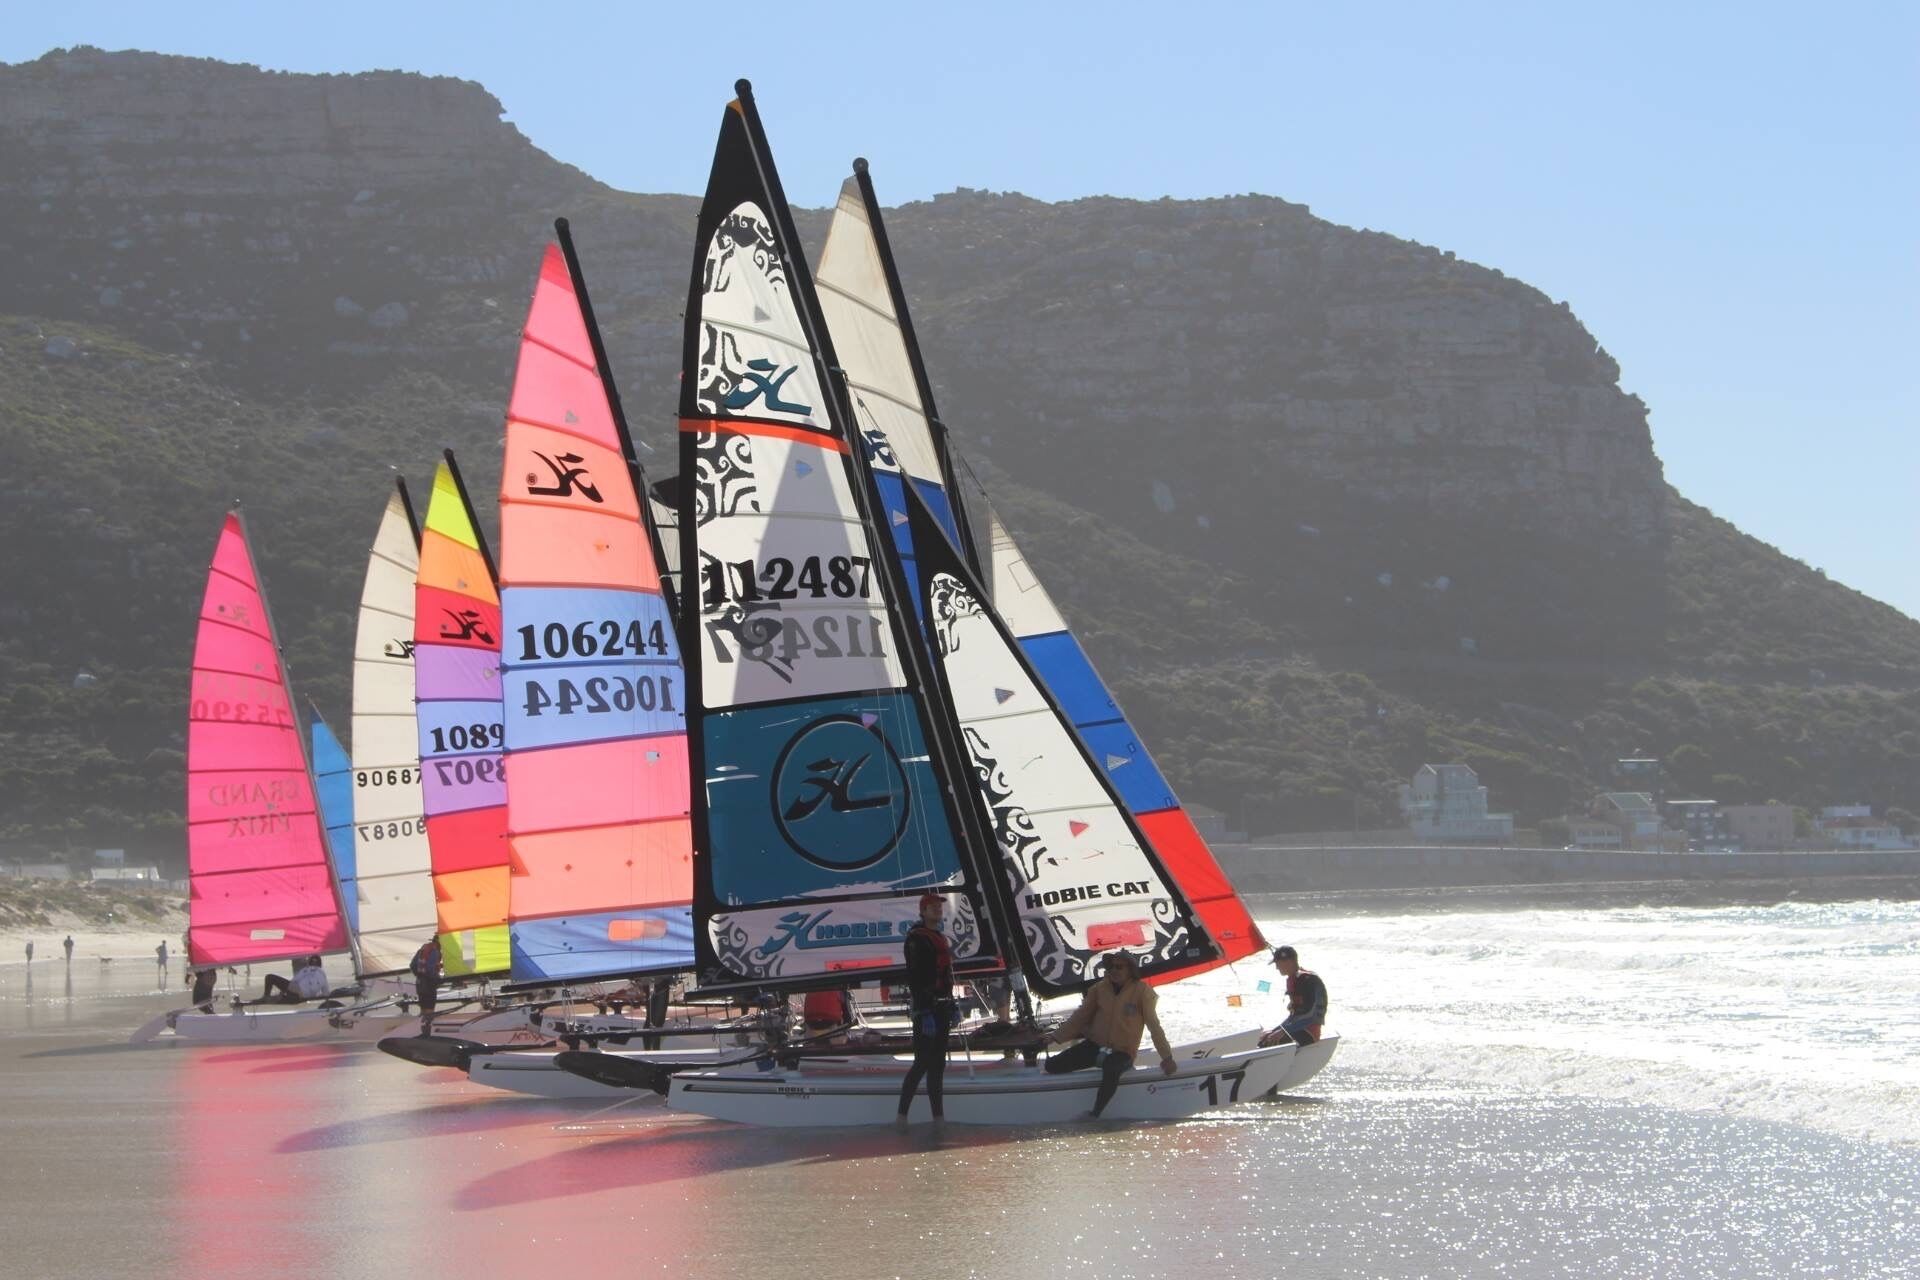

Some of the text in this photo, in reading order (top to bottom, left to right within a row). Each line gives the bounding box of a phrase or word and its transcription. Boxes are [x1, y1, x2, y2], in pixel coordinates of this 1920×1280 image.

[702, 556, 871, 603] 112487
[517, 619, 668, 660] 106244
[430, 723, 505, 753] 1089
[356, 768, 422, 787] 90687
[1025, 881, 1150, 909] HOBIE CAT
[816, 921, 892, 939] HOBIE
[1199, 1071, 1246, 1106] 17
